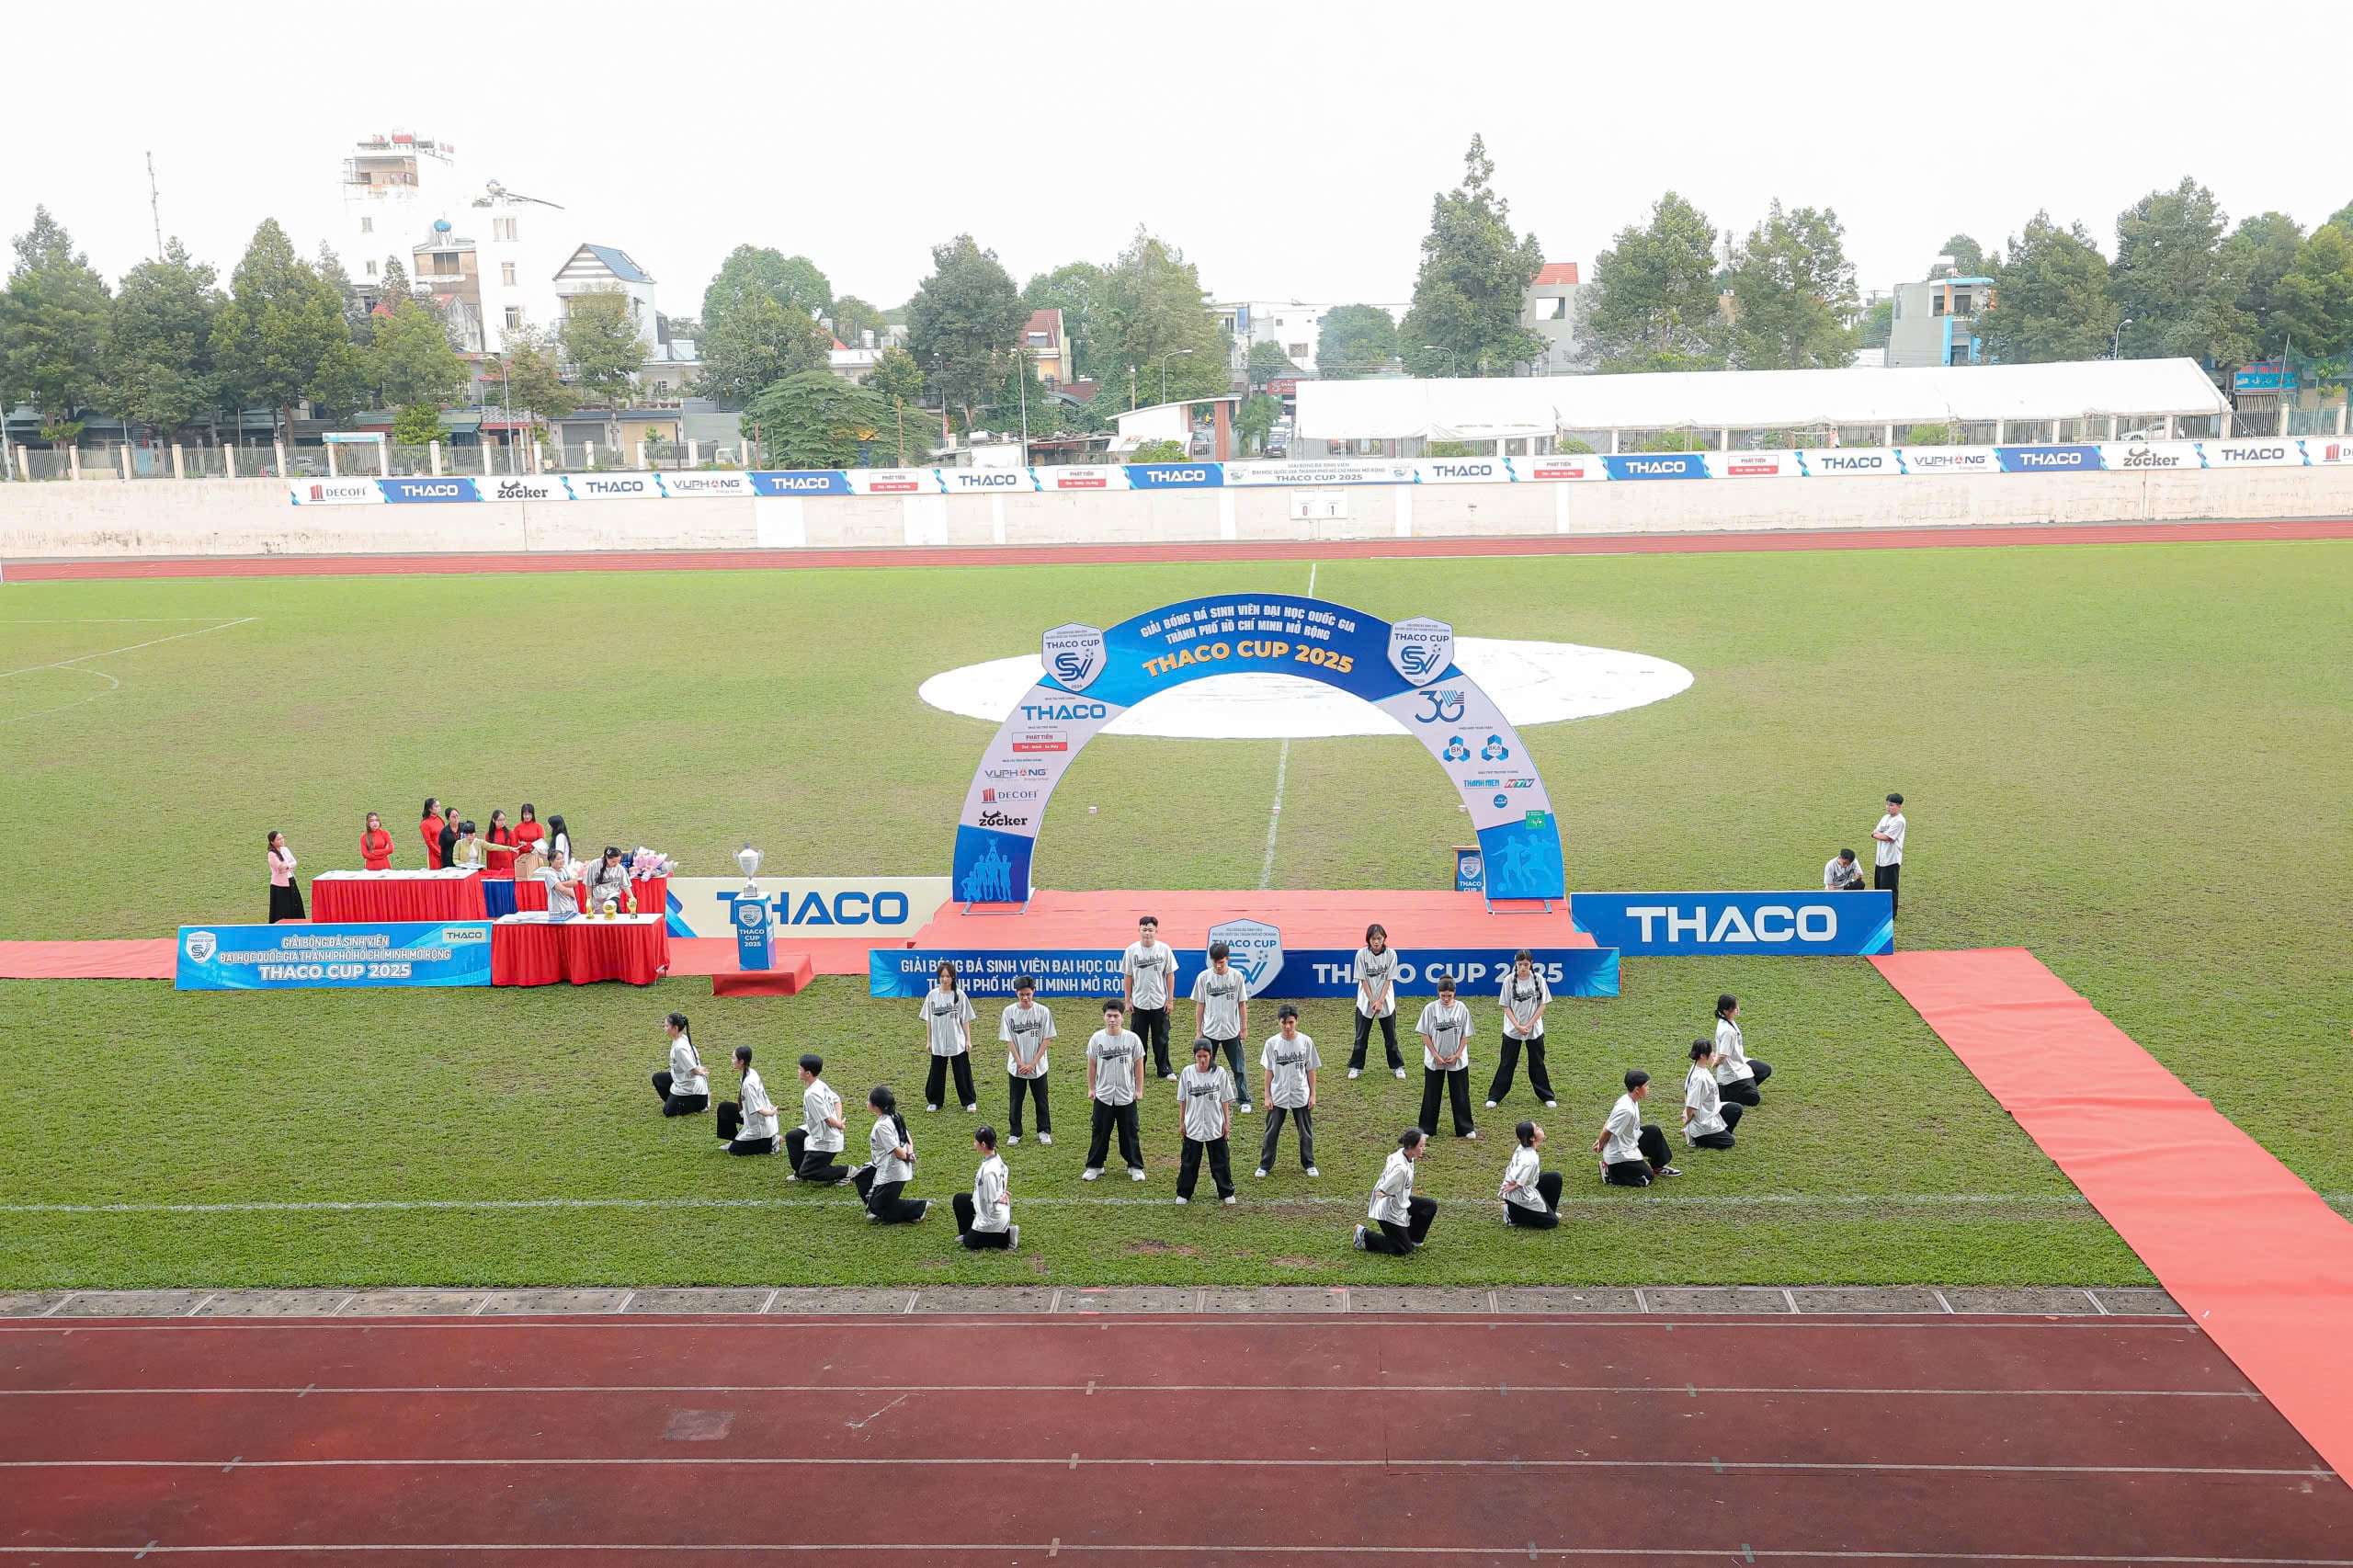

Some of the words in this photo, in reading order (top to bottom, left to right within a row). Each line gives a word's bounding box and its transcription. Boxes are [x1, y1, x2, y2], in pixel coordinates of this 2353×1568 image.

[2019, 452, 2082, 466] THACO
[2123, 453, 2179, 467] zocker
[2222, 448, 2284, 460] THACO
[1626, 460, 1687, 474] THACO
[1821, 457, 1882, 469] THACO
[1147, 470, 1205, 482] THACO
[1433, 464, 1493, 477] THACO
[586, 481, 643, 493] THACO
[772, 478, 830, 490] THACO
[959, 475, 1017, 486] THACO
[326, 486, 366, 496] DECOFI
[401, 484, 459, 496] THACO
[497, 485, 549, 498] zocker
[1140, 622, 1162, 638] GIẢI
[1163, 613, 1191, 630] BÓNG
[1193, 607, 1208, 621] ĐÁ
[1210, 606, 1234, 619] SINH
[1237, 603, 1260, 616] VIÊN
[1263, 605, 1281, 618] ĐẠI
[1284, 607, 1305, 620] HỌC
[1307, 609, 1336, 627] QUỐC
[1337, 618, 1356, 633] GIA
[1165, 628, 1197, 644] THÀNH
[1199, 620, 1218, 637] PHỐ
[1221, 619, 1234, 633] HỒ
[1237, 617, 1255, 631] CHÍ
[1257, 620, 1283, 632] MINH
[1285, 621, 1302, 634] MỞ
[1303, 625, 1331, 642] RỘNG
[1046, 641, 1079, 649] THACO
[1081, 639, 1100, 647] CUP
[1394, 633, 1427, 642] THACO
[1429, 634, 1449, 642] CUP
[1142, 642, 1231, 677] THACO
[1236, 640, 1290, 659] CUP
[1294, 644, 1354, 675] 2025
[1020, 704, 1107, 721] THACO
[1505, 778, 1535, 789] HTV
[998, 790, 1037, 799] DECOFI
[979, 815, 1029, 827] zocker
[717, 892, 909, 925] THACO
[1625, 905, 1837, 943] THACO
[282, 935, 301, 949] GIẢI
[303, 935, 329, 948] BÓNG
[329, 934, 343, 948] ĐÁ
[344, 936, 366, 948] SINH
[366, 934, 390, 948] VIÊN
[1254, 939, 1277, 948] CUP
[219, 951, 236, 964] ĐẠI
[237, 951, 256, 965] HỌC
[257, 949, 282, 963] QUỐC
[283, 951, 298, 962] GIA
[299, 949, 329, 962] THÀNH
[330, 948, 353, 961] PHỐ
[353, 948, 368, 961] HỒ
[368, 948, 385, 960] CHÍ
[385, 949, 409, 960] MINH
[409, 947, 423, 960] MỞ
[423, 949, 451, 962] RỘNG
[258, 964, 323, 981] THACO
[326, 963, 366, 980] CUP
[368, 962, 412, 979] 2025
[901, 956, 926, 973] GIẢI
[966, 957, 984, 973] ĐÁ
[986, 960, 1017, 973] SINH
[1019, 957, 1050, 973] VIÊN
[1052, 960, 1074, 975] ĐẠI
[1076, 960, 1103, 975] HỌC
[1425, 962, 1487, 983] CUP
[973, 974, 999, 992] PHỐ
[1046, 979, 1078, 992] MINH
[1081, 975, 1100, 992] MỞ
